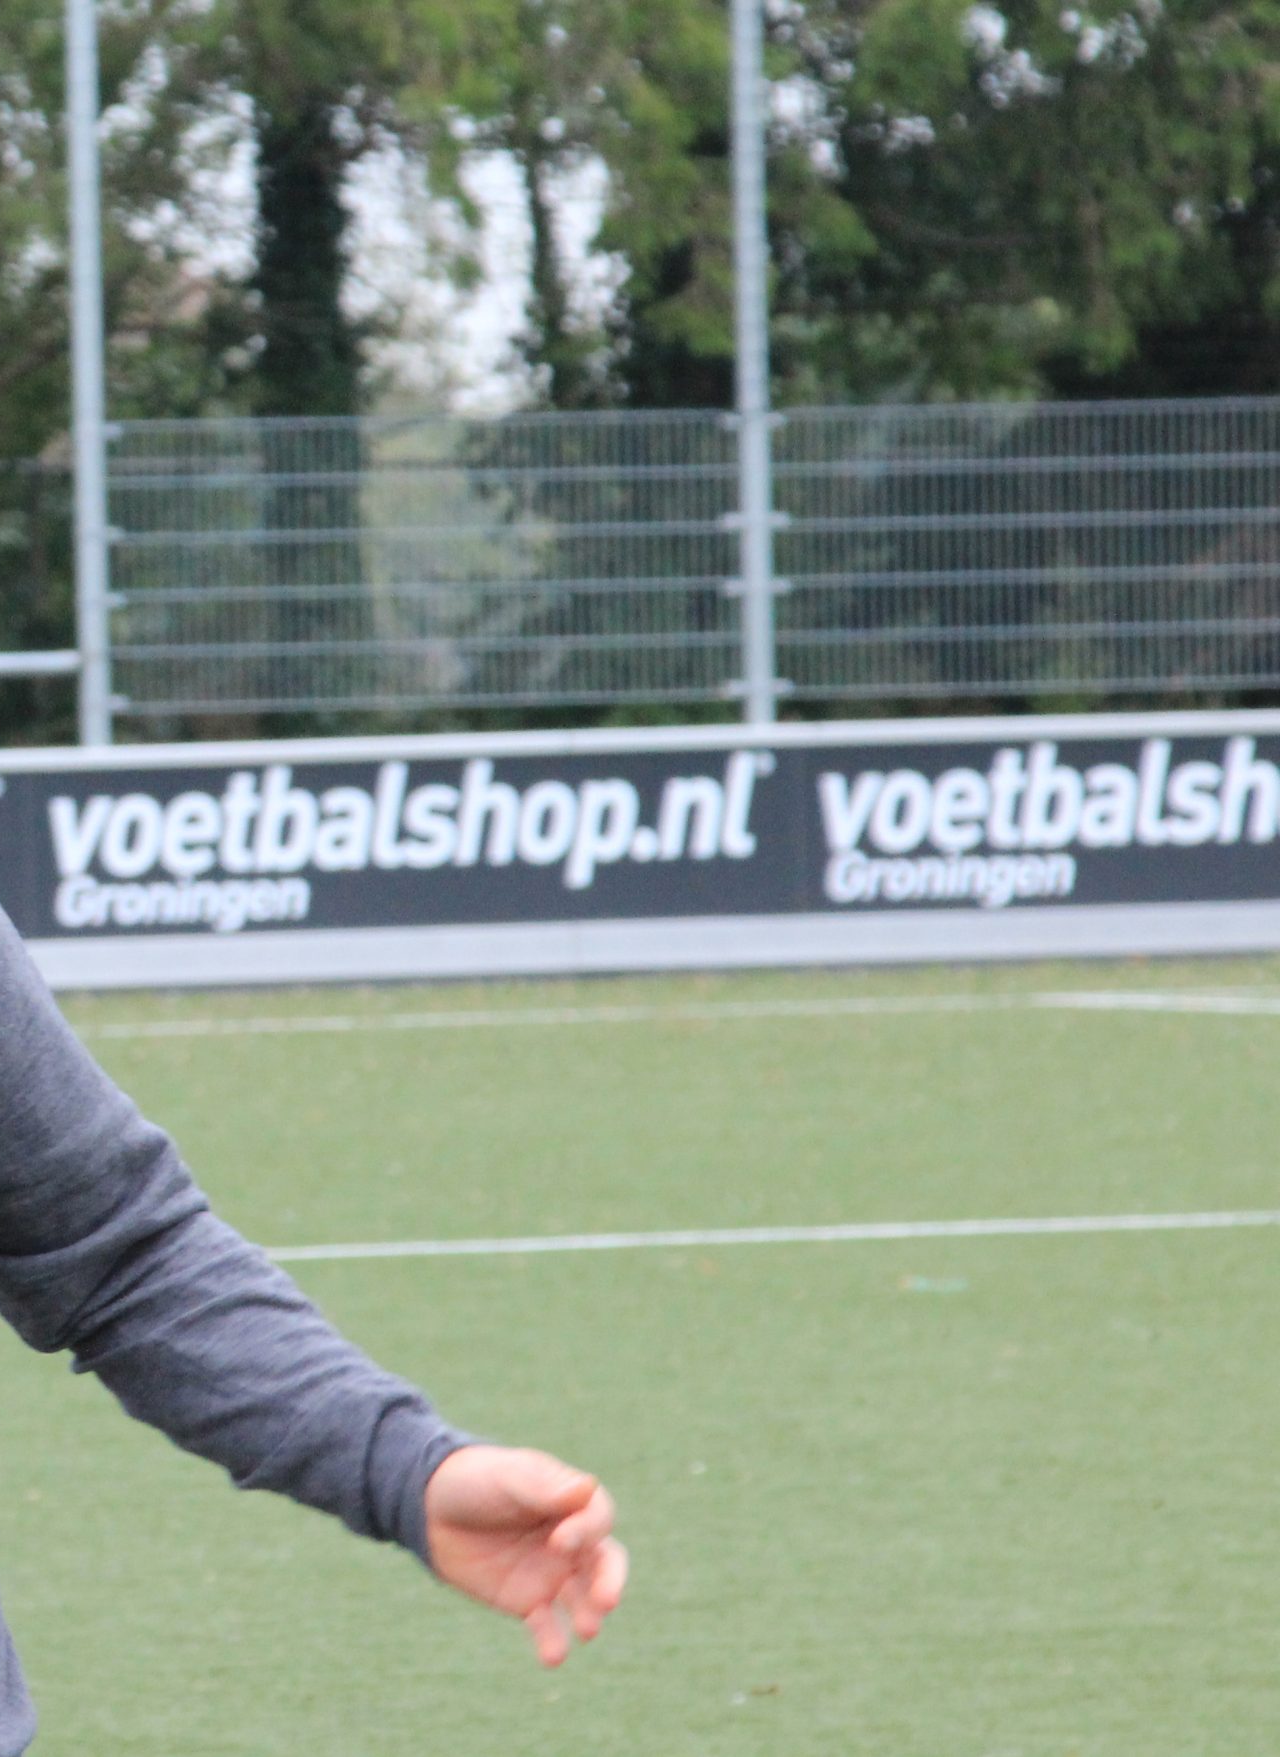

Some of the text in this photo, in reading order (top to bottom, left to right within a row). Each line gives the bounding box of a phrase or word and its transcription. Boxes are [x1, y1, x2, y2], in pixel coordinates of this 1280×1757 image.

[49, 750, 760, 889] voetbalshop.nl
[818, 737, 1280, 853] voetbalsh
[55, 876, 312, 932] Groningen
[825, 849, 1076, 907] Groningen
